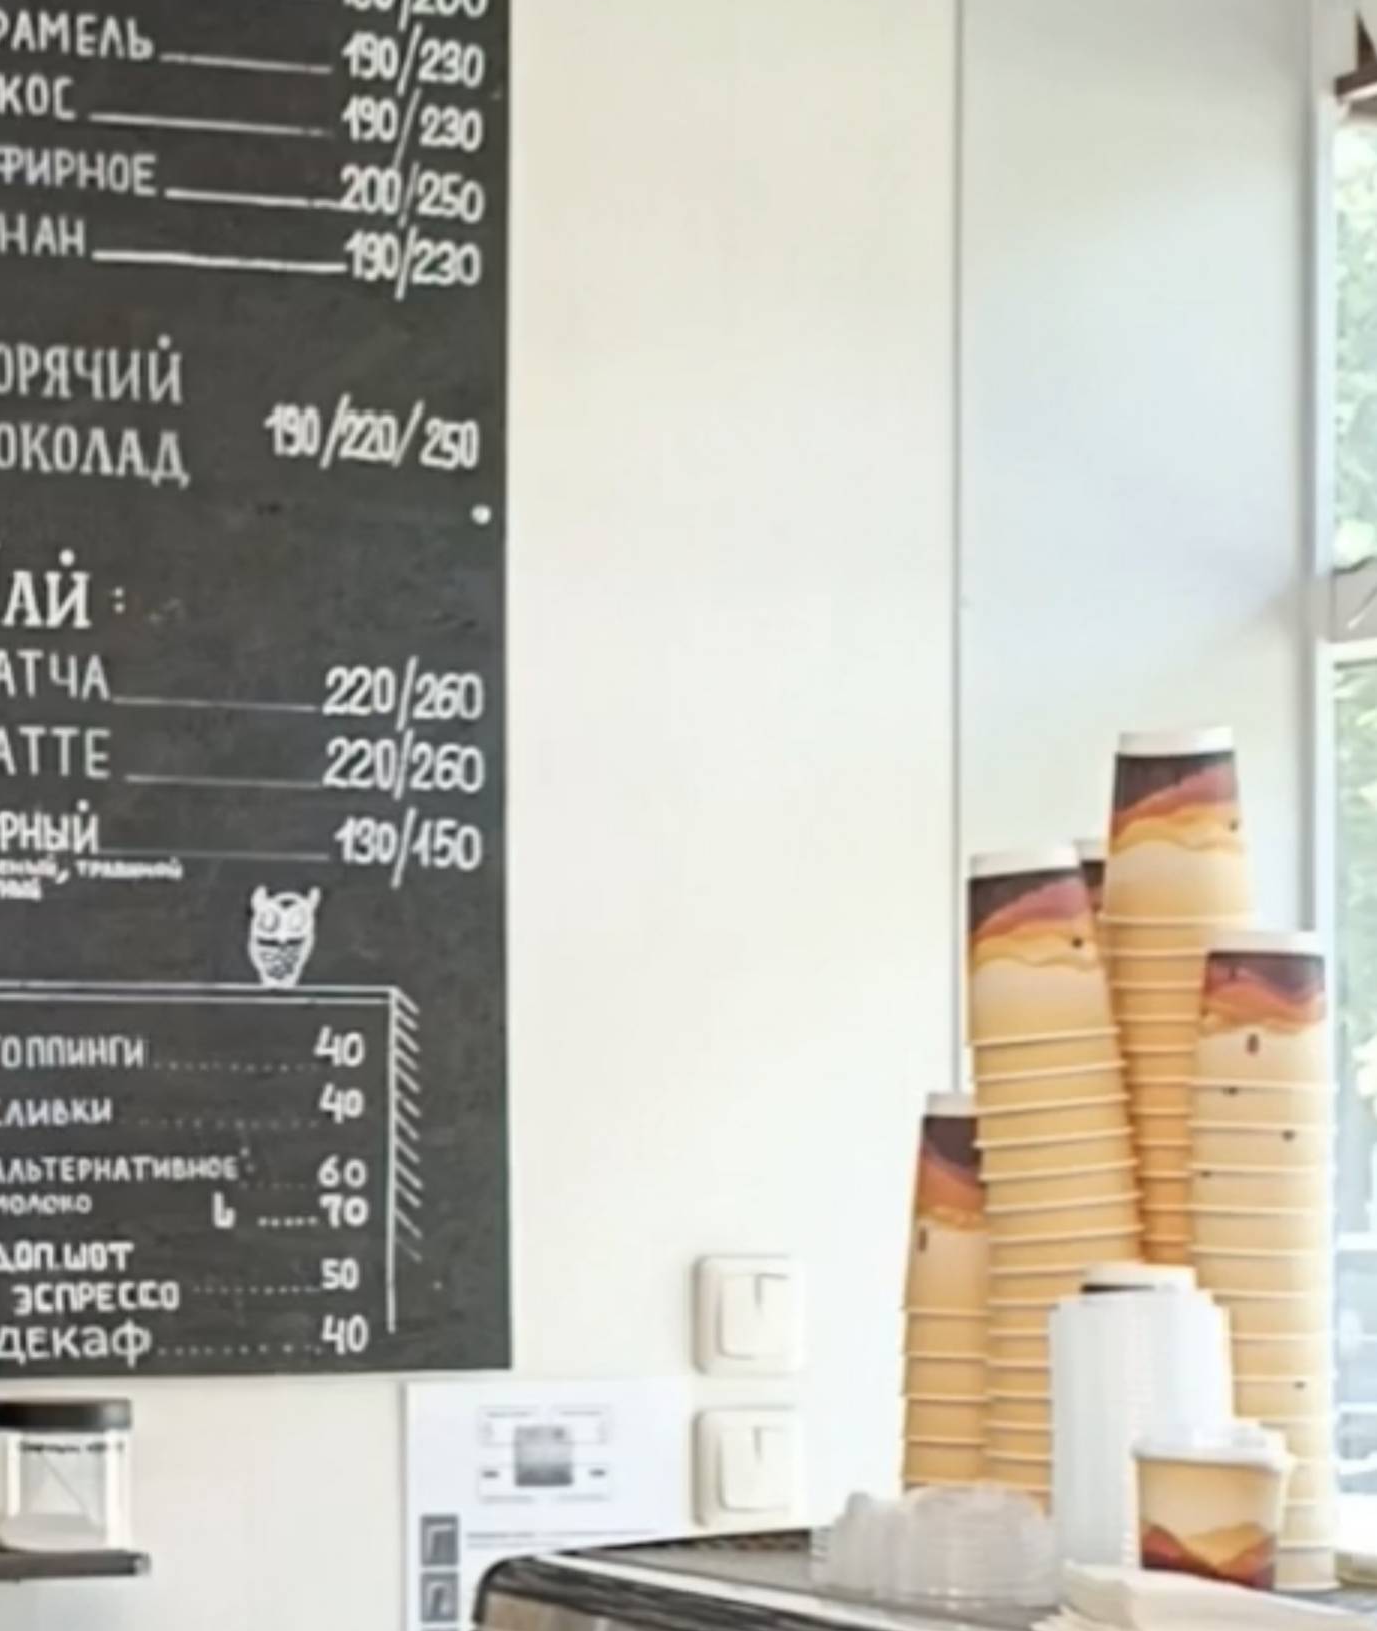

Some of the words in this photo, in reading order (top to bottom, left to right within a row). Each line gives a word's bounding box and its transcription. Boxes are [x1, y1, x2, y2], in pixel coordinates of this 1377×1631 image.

[342, 25, 483, 96] 190/230
[342, 88, 482, 166] 190/230
[340, 163, 483, 227] 200/250
[345, 227, 480, 299] 190/230
[324, 656, 484, 731] 220/260
[323, 730, 484, 798] 220/260
[314, 1028, 364, 1067] 40
[320, 1085, 363, 1123] 40
[319, 1157, 365, 1188] 60
[320, 1196, 368, 1227] 70
[13, 1282, 180, 1315] ЭСПРЕССО
[321, 1260, 359, 1291] 50
[322, 1316, 368, 1354] 40
